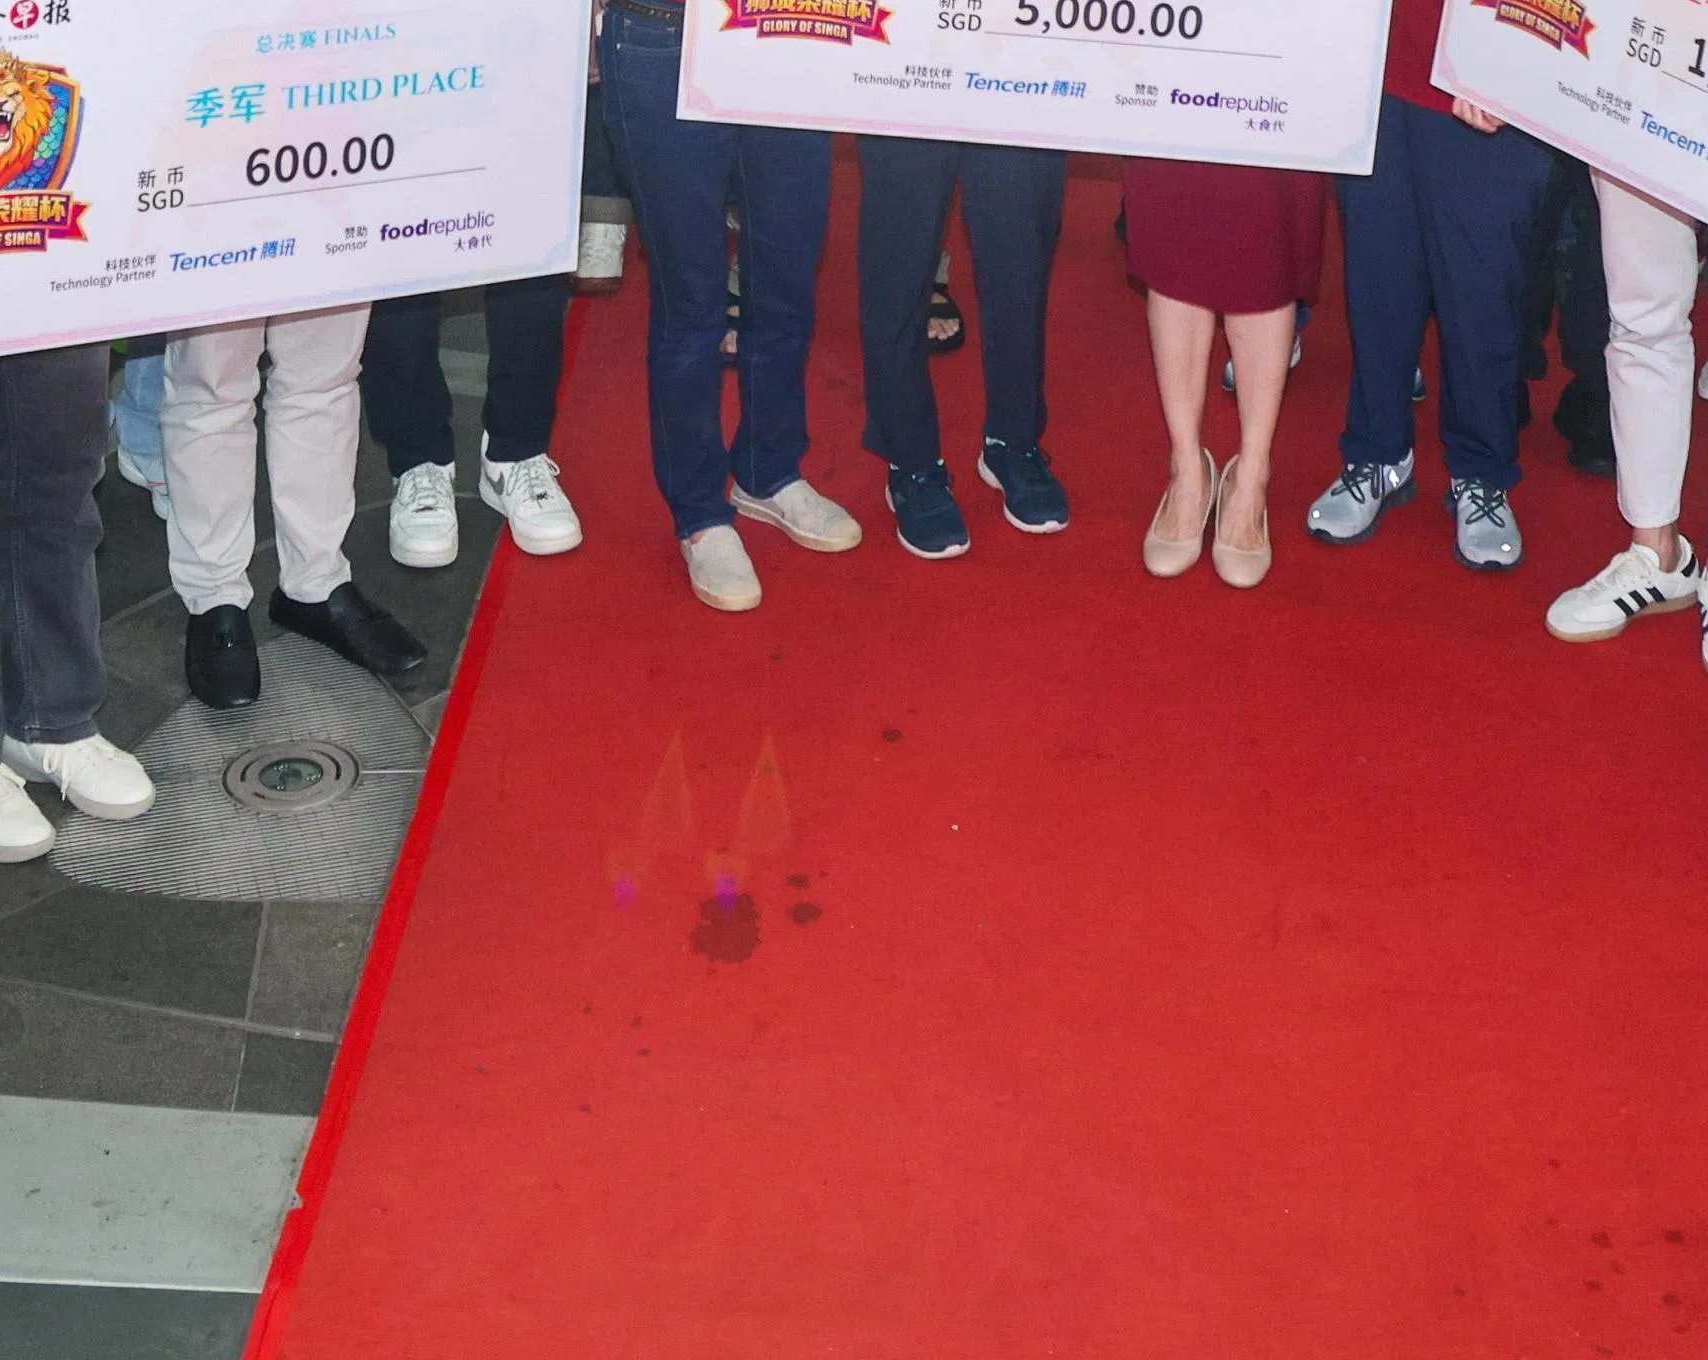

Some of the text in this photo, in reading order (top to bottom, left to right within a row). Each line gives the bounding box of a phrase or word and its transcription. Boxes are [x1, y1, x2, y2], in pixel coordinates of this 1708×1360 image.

[762, 20, 848, 39] GLORY OF SINGA
[937, 11, 982, 32] SGD
[1499, 4, 1560, 41] GLORY OF SINGA
[256, 23, 396, 54] 总决赛 FINALS
[1626, 38, 1662, 68] SGD
[853, 72, 951, 90] Technology Partner
[904, 65, 952, 79] 科技伙伴
[185, 65, 486, 128] 季军 THIRD PLACE
[963, 72, 1087, 99] Tencent 腾讯
[1115, 94, 1157, 110] Sponsor
[1171, 88, 1288, 116] foodrepublic
[1557, 80, 1631, 126] Technology Partner
[1244, 118, 1286, 134] 大食代
[1640, 110, 1706, 157] Tencent
[245, 133, 394, 187] 600.00
[137, 189, 185, 212] SGD
[380, 211, 494, 242] foodrepublic
[4, 232, 42, 248] SINGA
[325, 239, 367, 256] Sponsor
[453, 235, 492, 252] 大食代
[105, 254, 156, 271] 科技伙伴
[170, 238, 295, 272] Tencent 腾讯
[50, 268, 156, 292] Technology Partner
